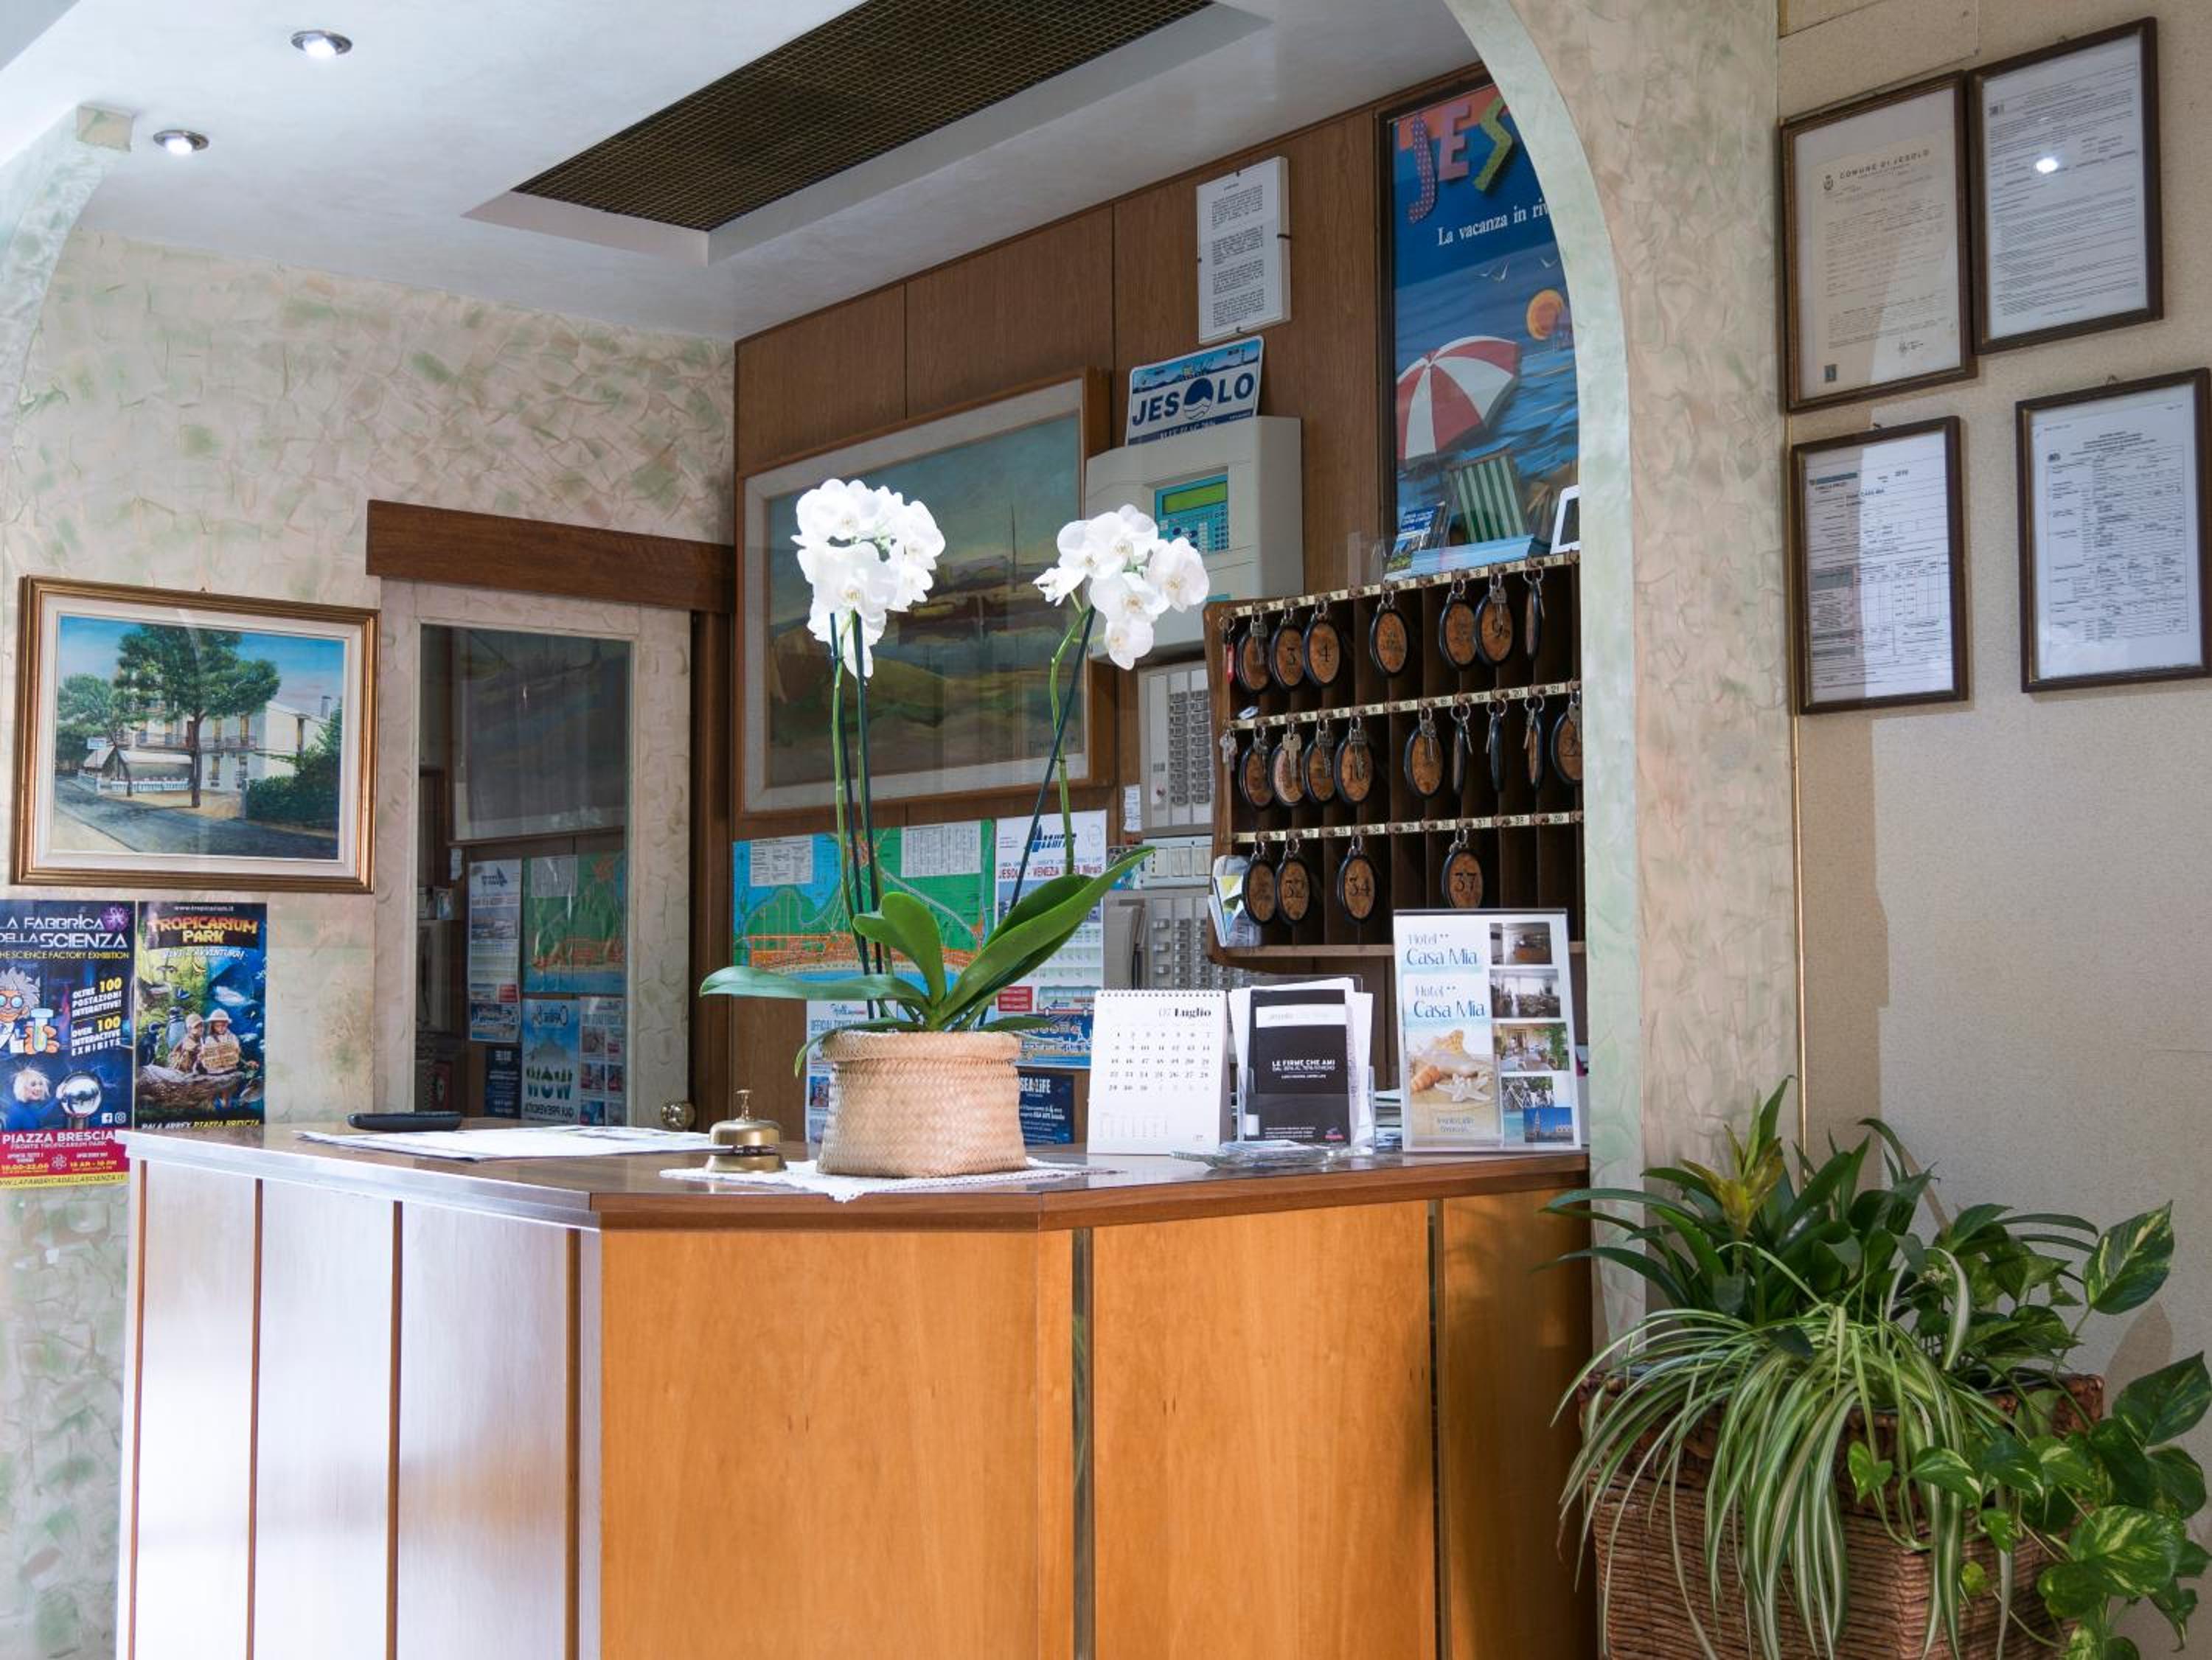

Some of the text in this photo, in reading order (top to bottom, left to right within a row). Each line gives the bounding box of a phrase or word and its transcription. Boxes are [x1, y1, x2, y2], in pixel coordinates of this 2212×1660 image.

[1438, 227, 1453, 245] La
[1458, 214, 1508, 240] vacanza
[1514, 204, 1527, 224] in
[1513, 689, 1523, 697] 20
[1551, 685, 1561, 694] 21
[1455, 873, 1478, 893] 37
[149, 915, 258, 934] TROPICARIUM
[40, 932, 128, 949] SCIENZA
[182, 929, 225, 944] PARK
[1408, 932, 1437, 944] Hotel
[12, 951, 48, 959] SCIENCE
[49, 950, 86, 959] FACTORY
[88, 950, 130, 959] EXHIBITION
[1406, 947, 1478, 966] Casa Mia
[100, 977, 122, 993] 100
[1415, 985, 1444, 997] Hotel
[72, 990, 122, 1008] POSTAZIONI
[1175, 1008, 1211, 1019] Luglio
[1413, 1000, 1486, 1018] Casa Mia
[97, 1016, 121, 1033] 100
[72, 1038, 121, 1056] EXHIBITS
[3, 1131, 115, 1144] PIAZZA BRESCIA
